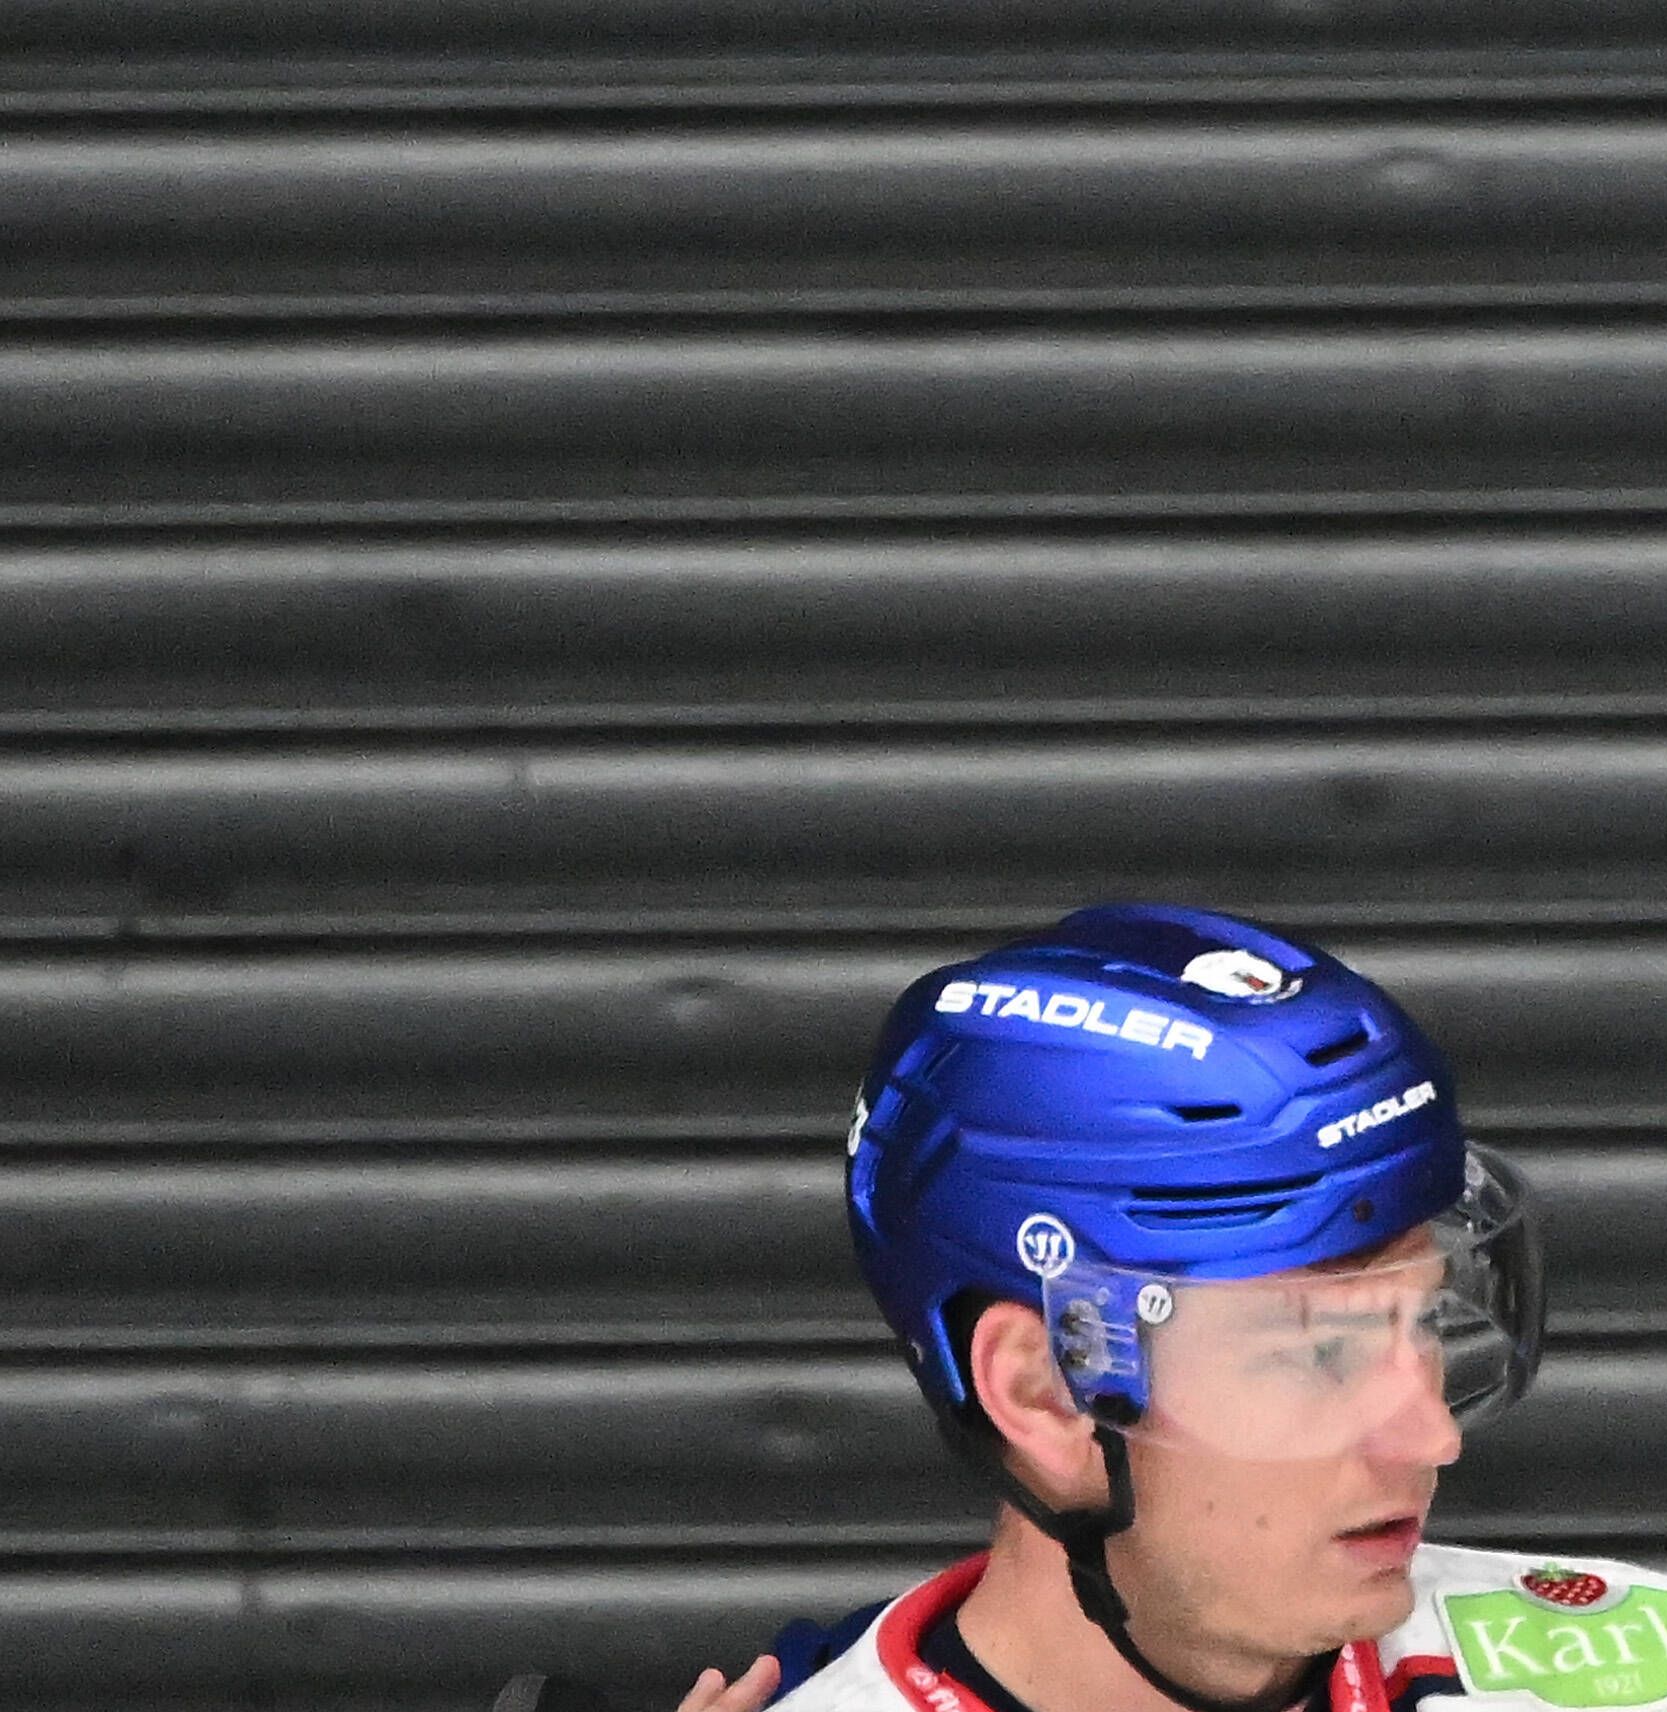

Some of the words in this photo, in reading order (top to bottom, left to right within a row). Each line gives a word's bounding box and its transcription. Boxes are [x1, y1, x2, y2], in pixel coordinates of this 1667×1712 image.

[934, 981, 1215, 1059] STADLER
[1316, 1080, 1438, 1148] STADLER
[1594, 1673, 1643, 1696] 1921
